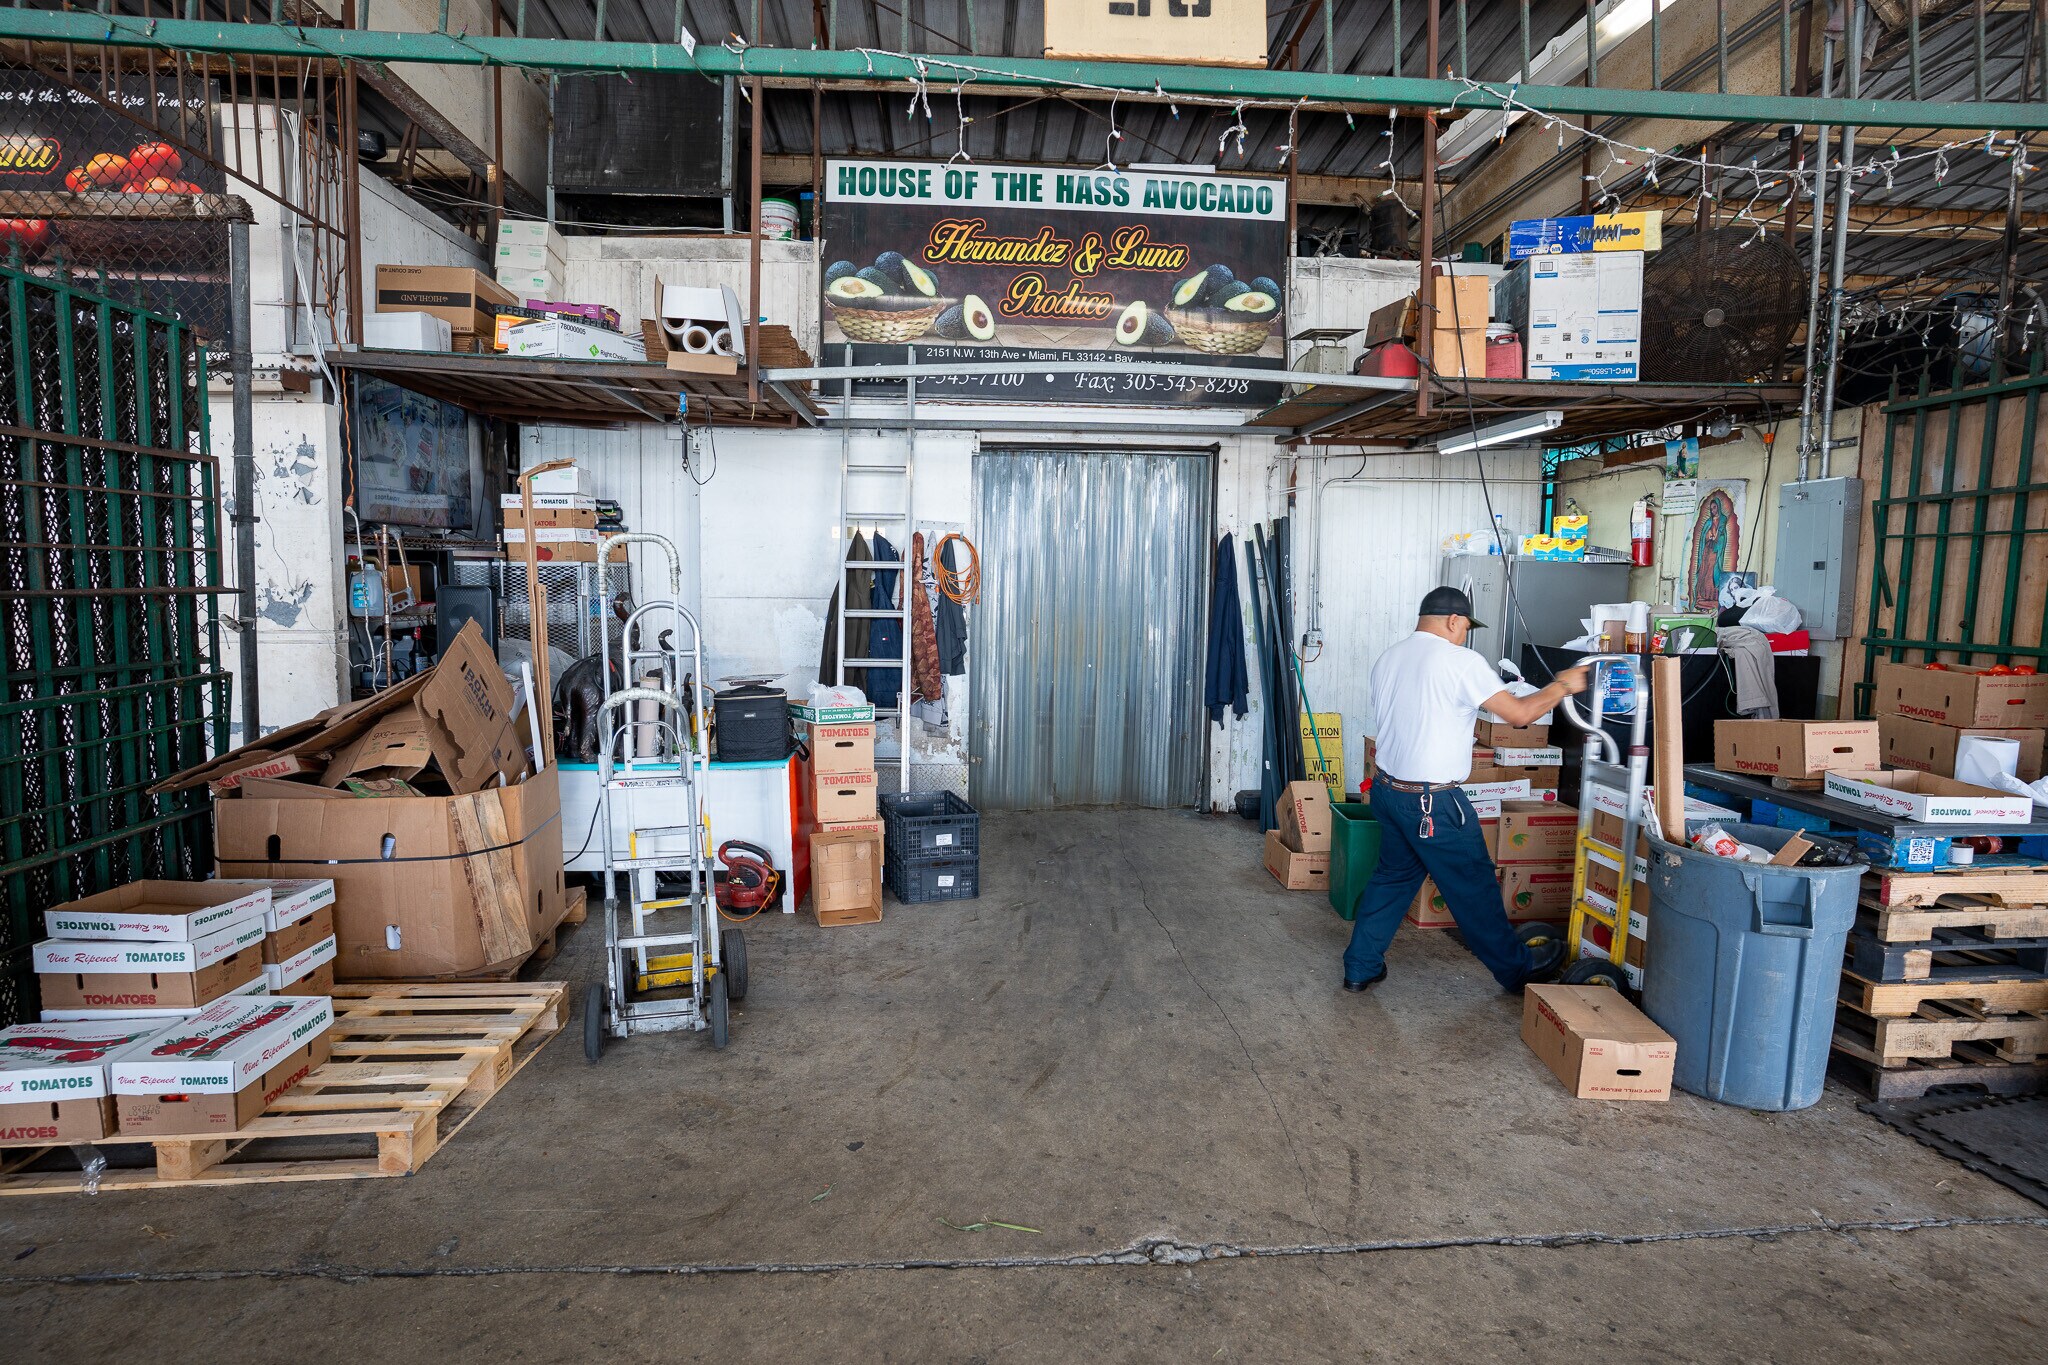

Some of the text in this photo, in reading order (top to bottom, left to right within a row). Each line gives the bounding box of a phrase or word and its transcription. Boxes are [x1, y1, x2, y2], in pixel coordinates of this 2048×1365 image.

[67, 89, 99, 105] Vin
[838, 166, 1273, 215] HOUSE OF THE HASS AVOCADO
[927, 221, 1186, 274] Hernandez & Luna
[401, 294, 443, 303] HIGHLAND
[1008, 276, 1111, 317] Produce
[600, 349, 613, 359] Right
[926, 348, 950, 358] 2151
[953, 349, 976, 358] N.W.
[979, 349, 999, 359] 13th
[1001, 350, 1020, 359] Ave
[1028, 351, 1059, 361] Miami,
[1062, 351, 1074, 361] FL
[1076, 352, 1106, 362] 33142
[1115, 353, 1133, 363] Bay
[1074, 372, 1250, 394] Fax: 305-545-8298
[464, 668, 493, 713] ROTH
[1899, 704, 1946, 720] TOMATOES
[820, 727, 869, 738] TOMATOES
[1302, 727, 1339, 736] CAUTION
[1312, 760, 1332, 772] WT
[1736, 760, 1779, 773] TOMATOES
[1888, 754, 1932, 772] TOMATOES
[217, 760, 292, 789] TOMAOES
[823, 774, 872, 786] TOMATOES
[1602, 796, 1625, 809] Ripened
[1828, 780, 1914, 811] Vine Ripened TOMATOES
[1296, 798, 1308, 834] TOMATOES
[1930, 808, 1971, 816] TOMATOES
[1974, 809, 2006, 817] Ripened
[829, 824, 879, 833] TOMATOES
[1600, 831, 1622, 845] TOMA
[1594, 881, 1618, 897] TOMAT
[290, 899, 309, 913] Ripened
[309, 887, 332, 903] TOMATOES
[1587, 894, 1609, 912] Ripened
[194, 907, 233, 926] TOMATOES
[56, 921, 170, 933] Vine Ripened TOMATOES
[200, 927, 263, 960] Vine Ripened TOMATOES
[47, 952, 186, 964] Vine Ripened TOMATOES
[294, 953, 312, 968] Ripened
[311, 939, 334, 957] TOMATOES
[244, 983, 267, 996] OMATOES
[83, 994, 157, 1005] TOMATOES
[1537, 1002, 1566, 1036] TOMATOES
[242, 1059, 260, 1075] Vine
[261, 1034, 291, 1062] Ripened
[291, 1010, 327, 1041] TOMATOES
[21, 1076, 93, 1092] TOMATOES
[117, 1076, 228, 1085] Vine Ripened TOMATOES
[264, 1064, 310, 1106] TOMATOES
[0, 1126, 58, 1140] MATOES
